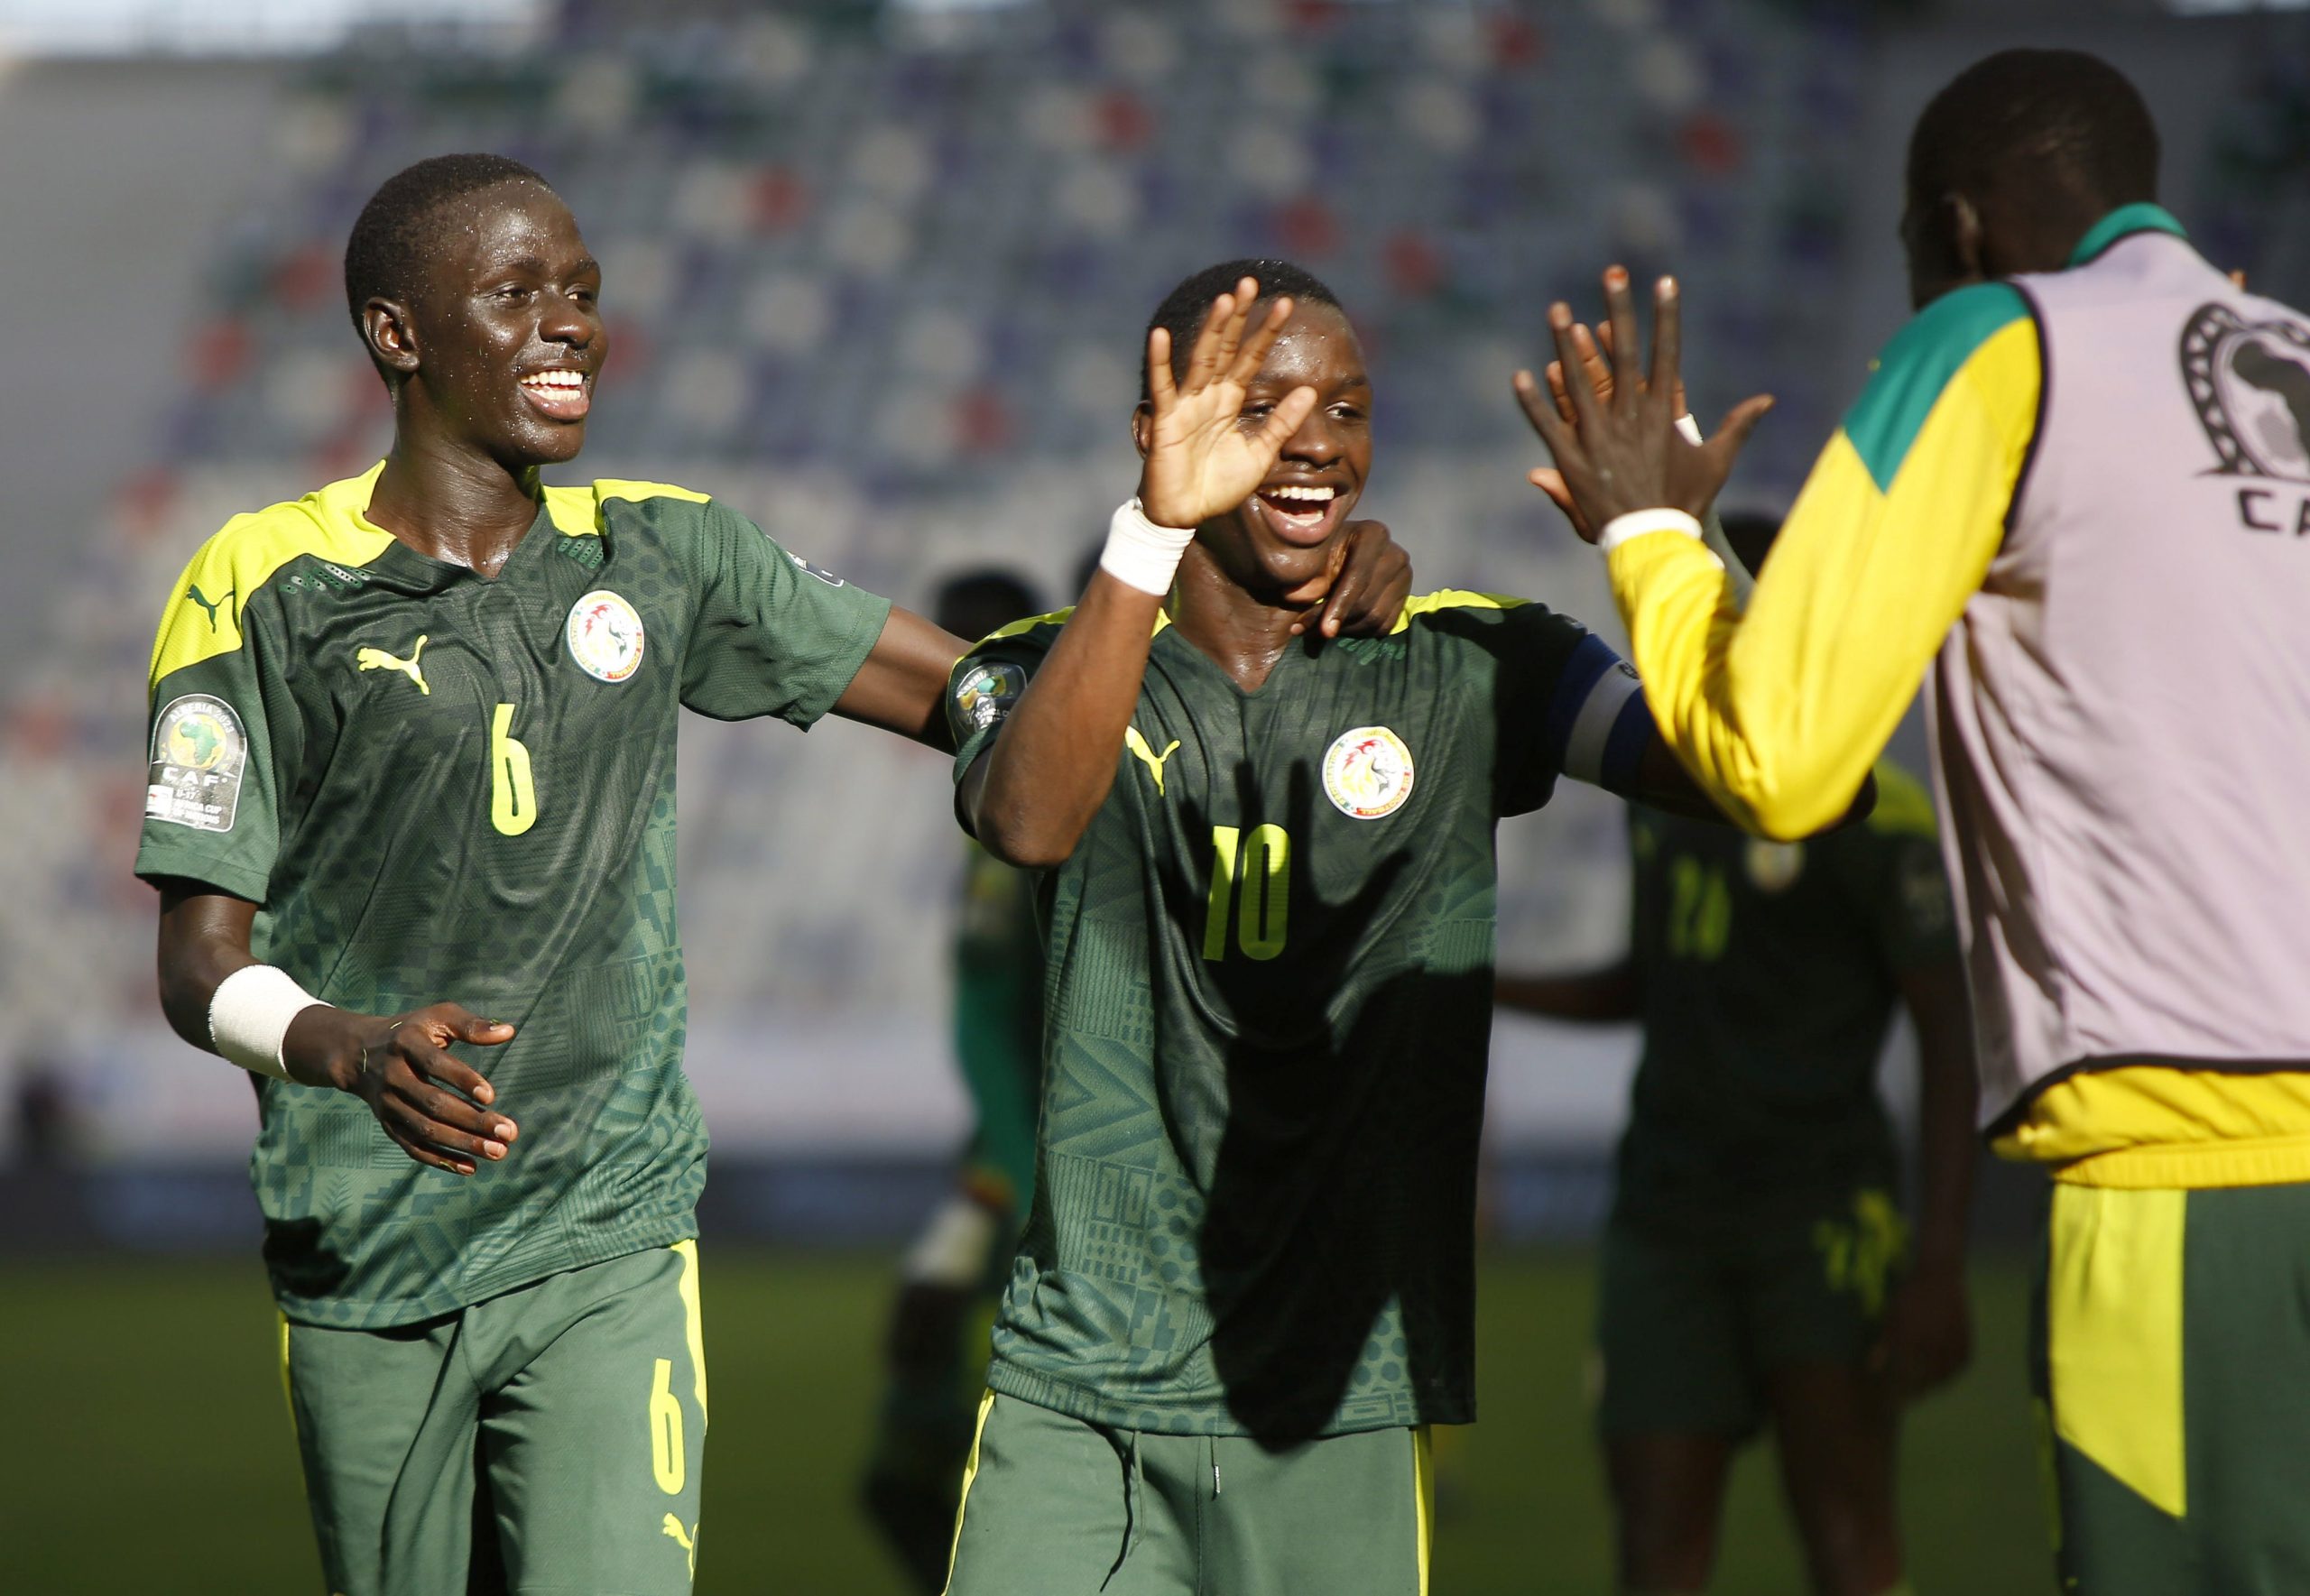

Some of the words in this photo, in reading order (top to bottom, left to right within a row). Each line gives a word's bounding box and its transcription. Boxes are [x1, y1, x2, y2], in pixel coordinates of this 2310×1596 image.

[169, 701, 213, 723] ALGERIA
[214, 707, 235, 733] 2023
[162, 766, 220, 787] CAF
[205, 804, 223, 815] CUP
[492, 703, 538, 836] 6
[1203, 823, 1291, 962] 10
[649, 1357, 686, 1496] 6
